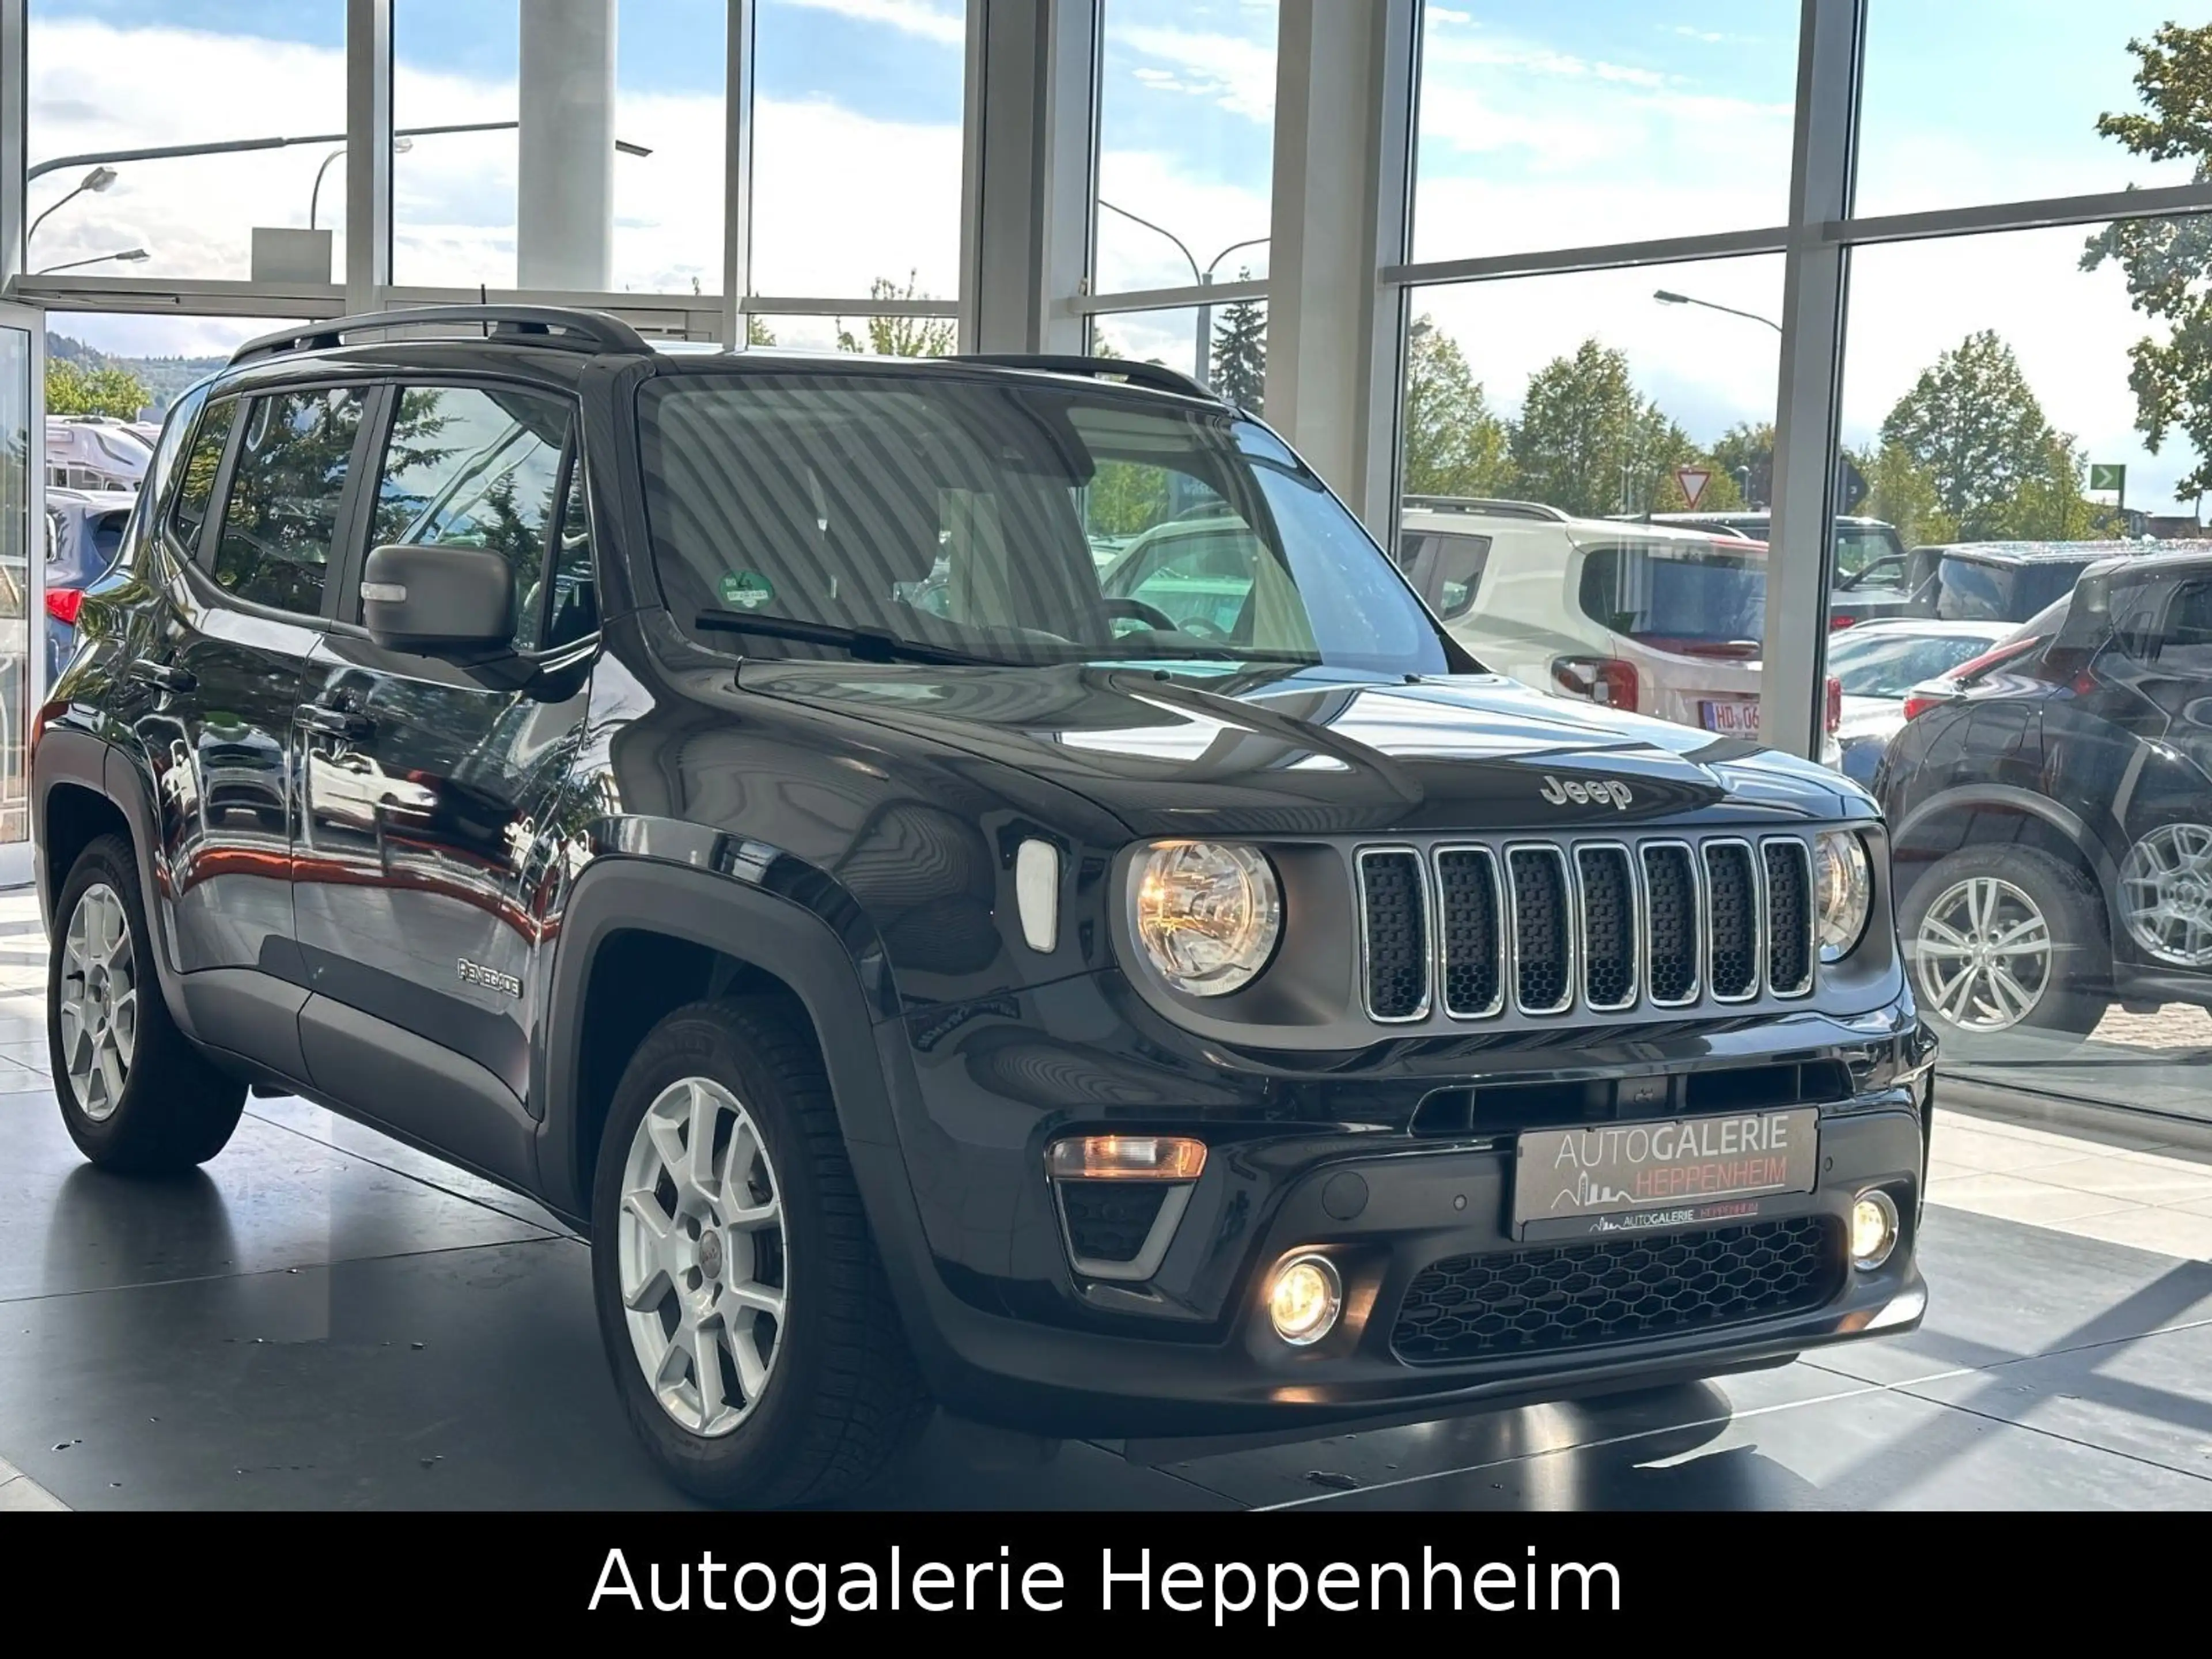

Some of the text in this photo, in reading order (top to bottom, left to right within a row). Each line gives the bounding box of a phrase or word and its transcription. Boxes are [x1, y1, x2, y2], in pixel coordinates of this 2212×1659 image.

[1717, 704, 1734, 729] HD
[1540, 775, 1633, 810] Jeep
[457, 957, 522, 999] RENEGADE
[1555, 1115, 1789, 1168] AUTOGALERIE
[1635, 1156, 1786, 1196] HEPPENHEIM
[1623, 1210, 1694, 1227] AUTOGALERIE
